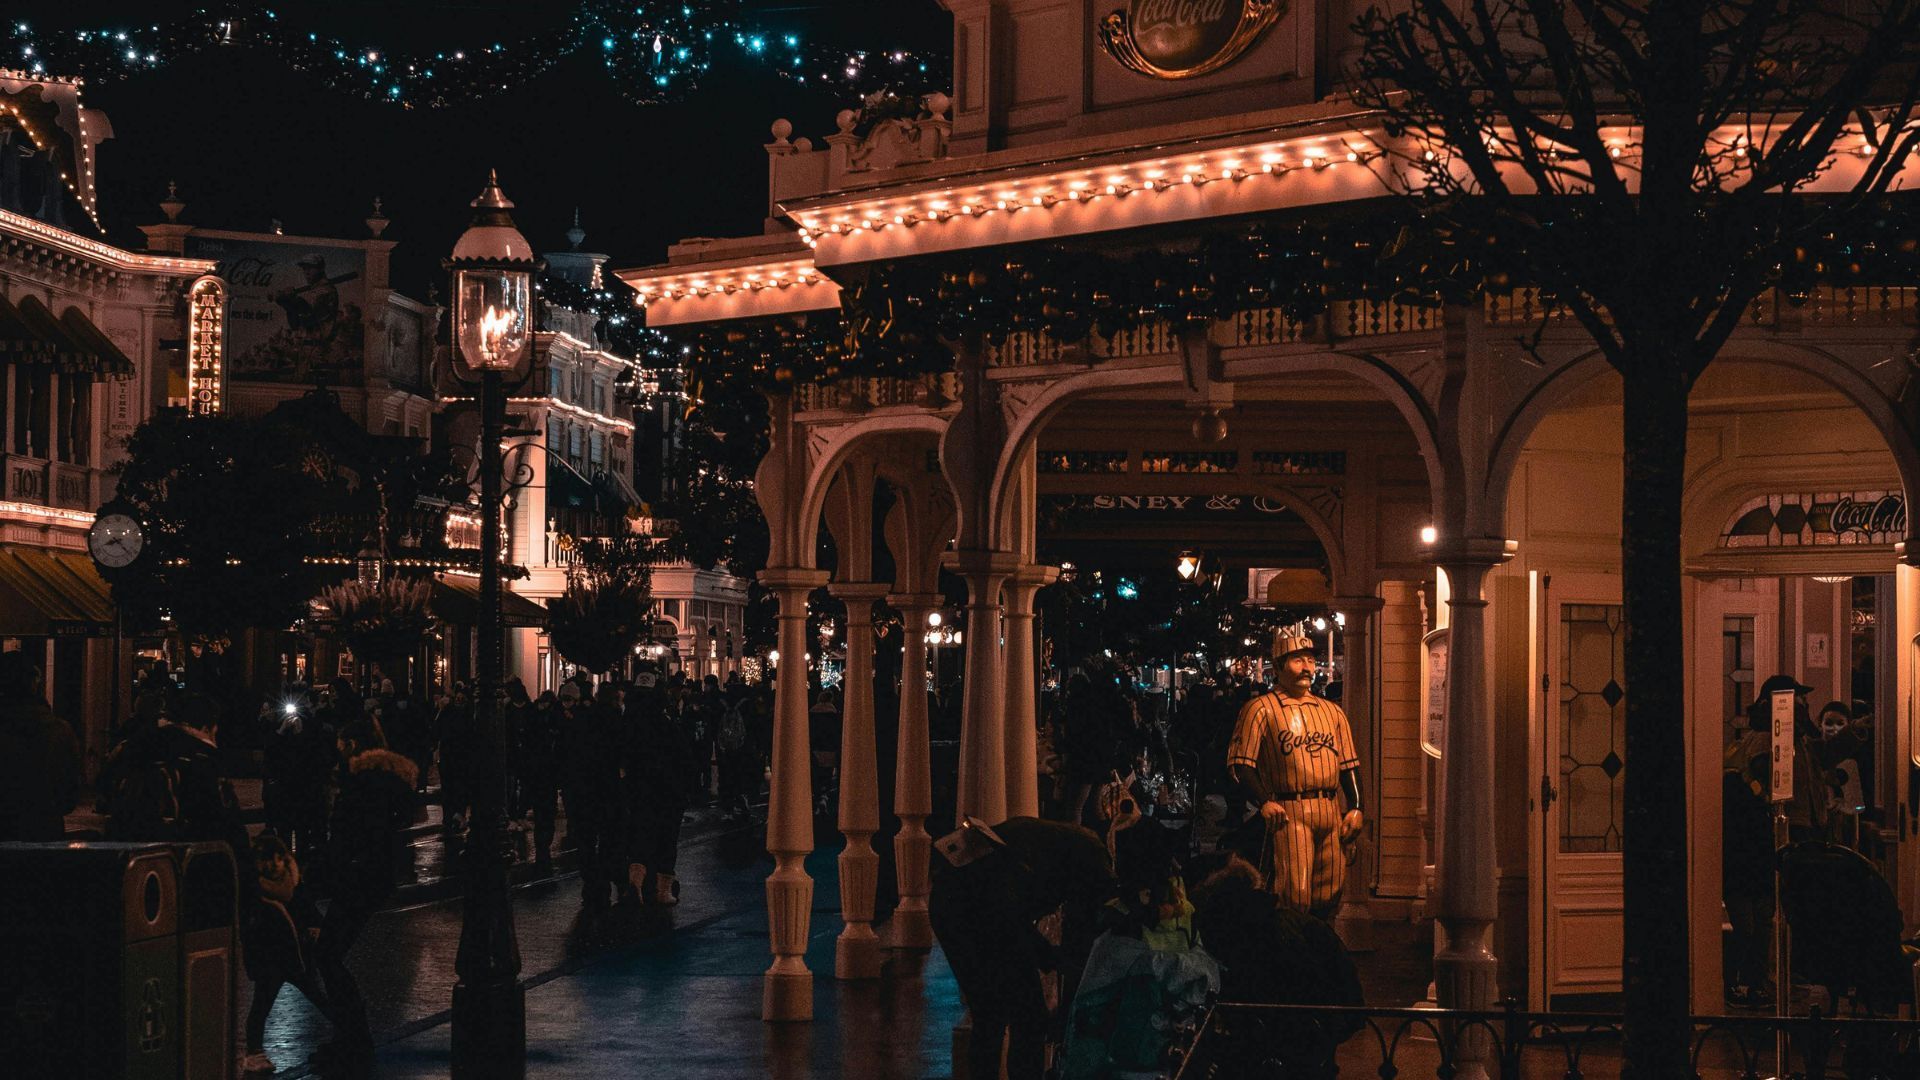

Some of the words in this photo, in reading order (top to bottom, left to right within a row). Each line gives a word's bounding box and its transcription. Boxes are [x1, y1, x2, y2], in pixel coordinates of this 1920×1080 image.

[200, 294, 216, 369] MARKET
[199, 378, 213, 414] HOU
[1093, 494, 1192, 510] SNEY
[1278, 730, 1339, 756] Casey's
